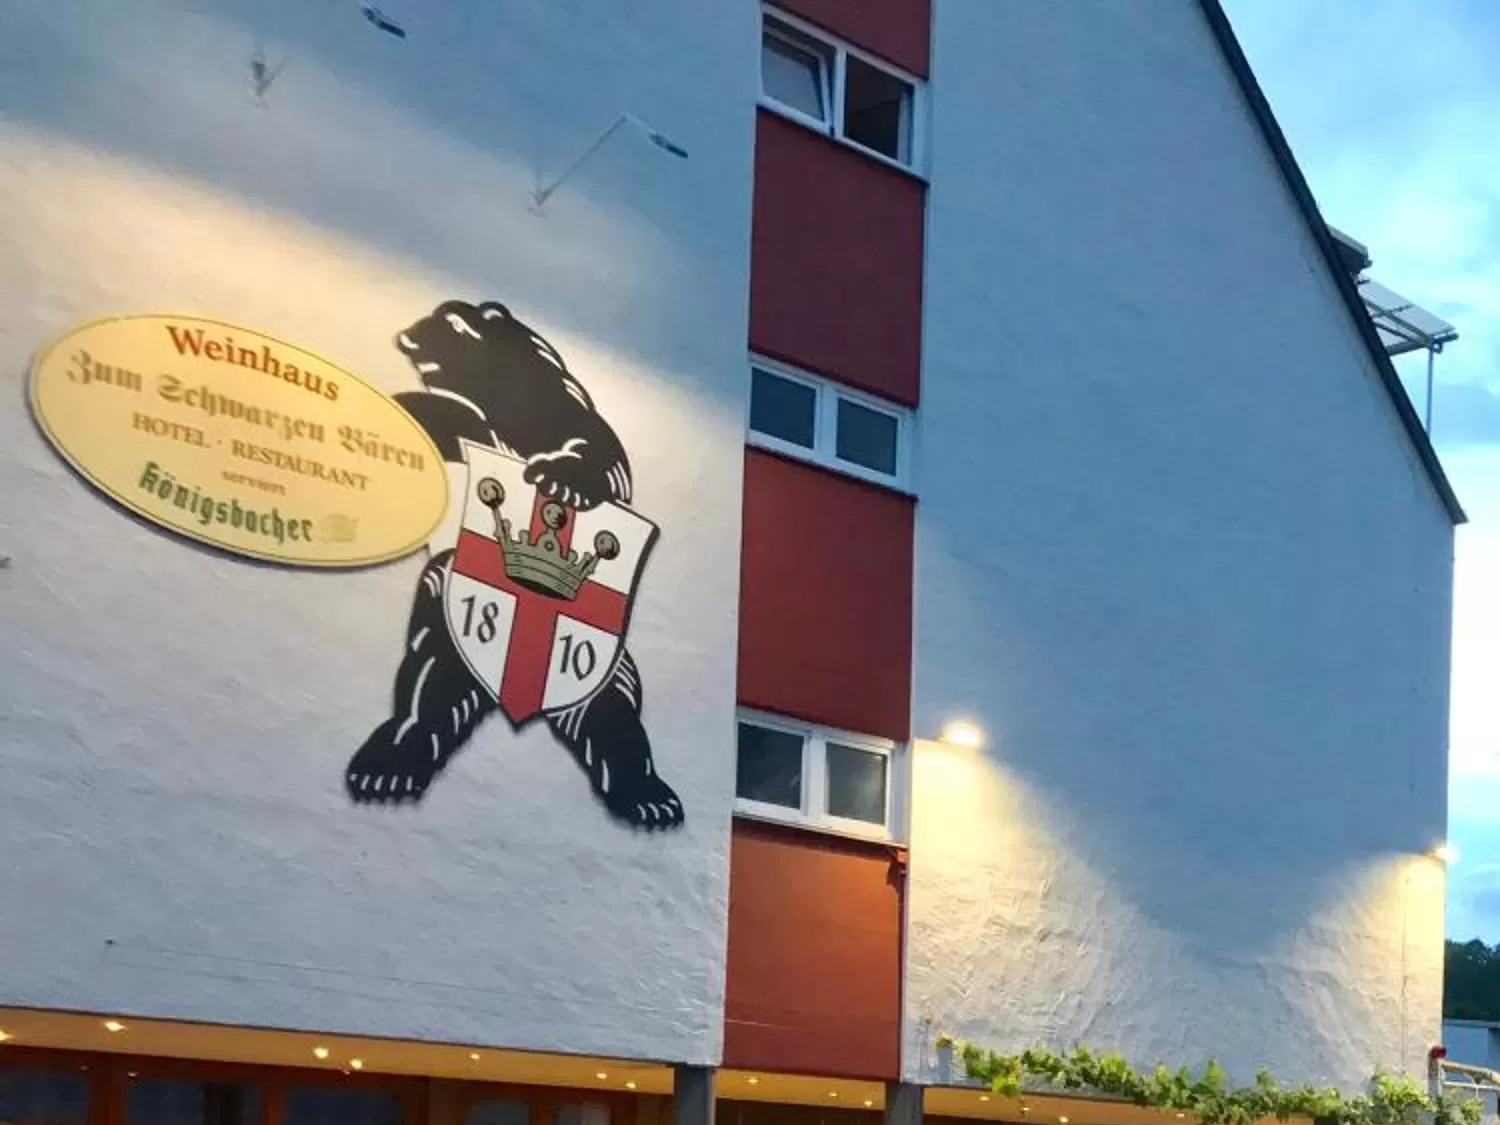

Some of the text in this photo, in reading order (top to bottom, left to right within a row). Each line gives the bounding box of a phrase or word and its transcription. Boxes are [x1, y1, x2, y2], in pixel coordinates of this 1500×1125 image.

[165, 324, 340, 402] Weinhaus
[66, 349, 425, 472] Zum Schwarzen Bären
[132, 412, 371, 491] HOTEL RESTAURANT
[138, 460, 314, 543] Königsbacher
[460, 594, 499, 644] 18
[559, 634, 597, 681] 10
